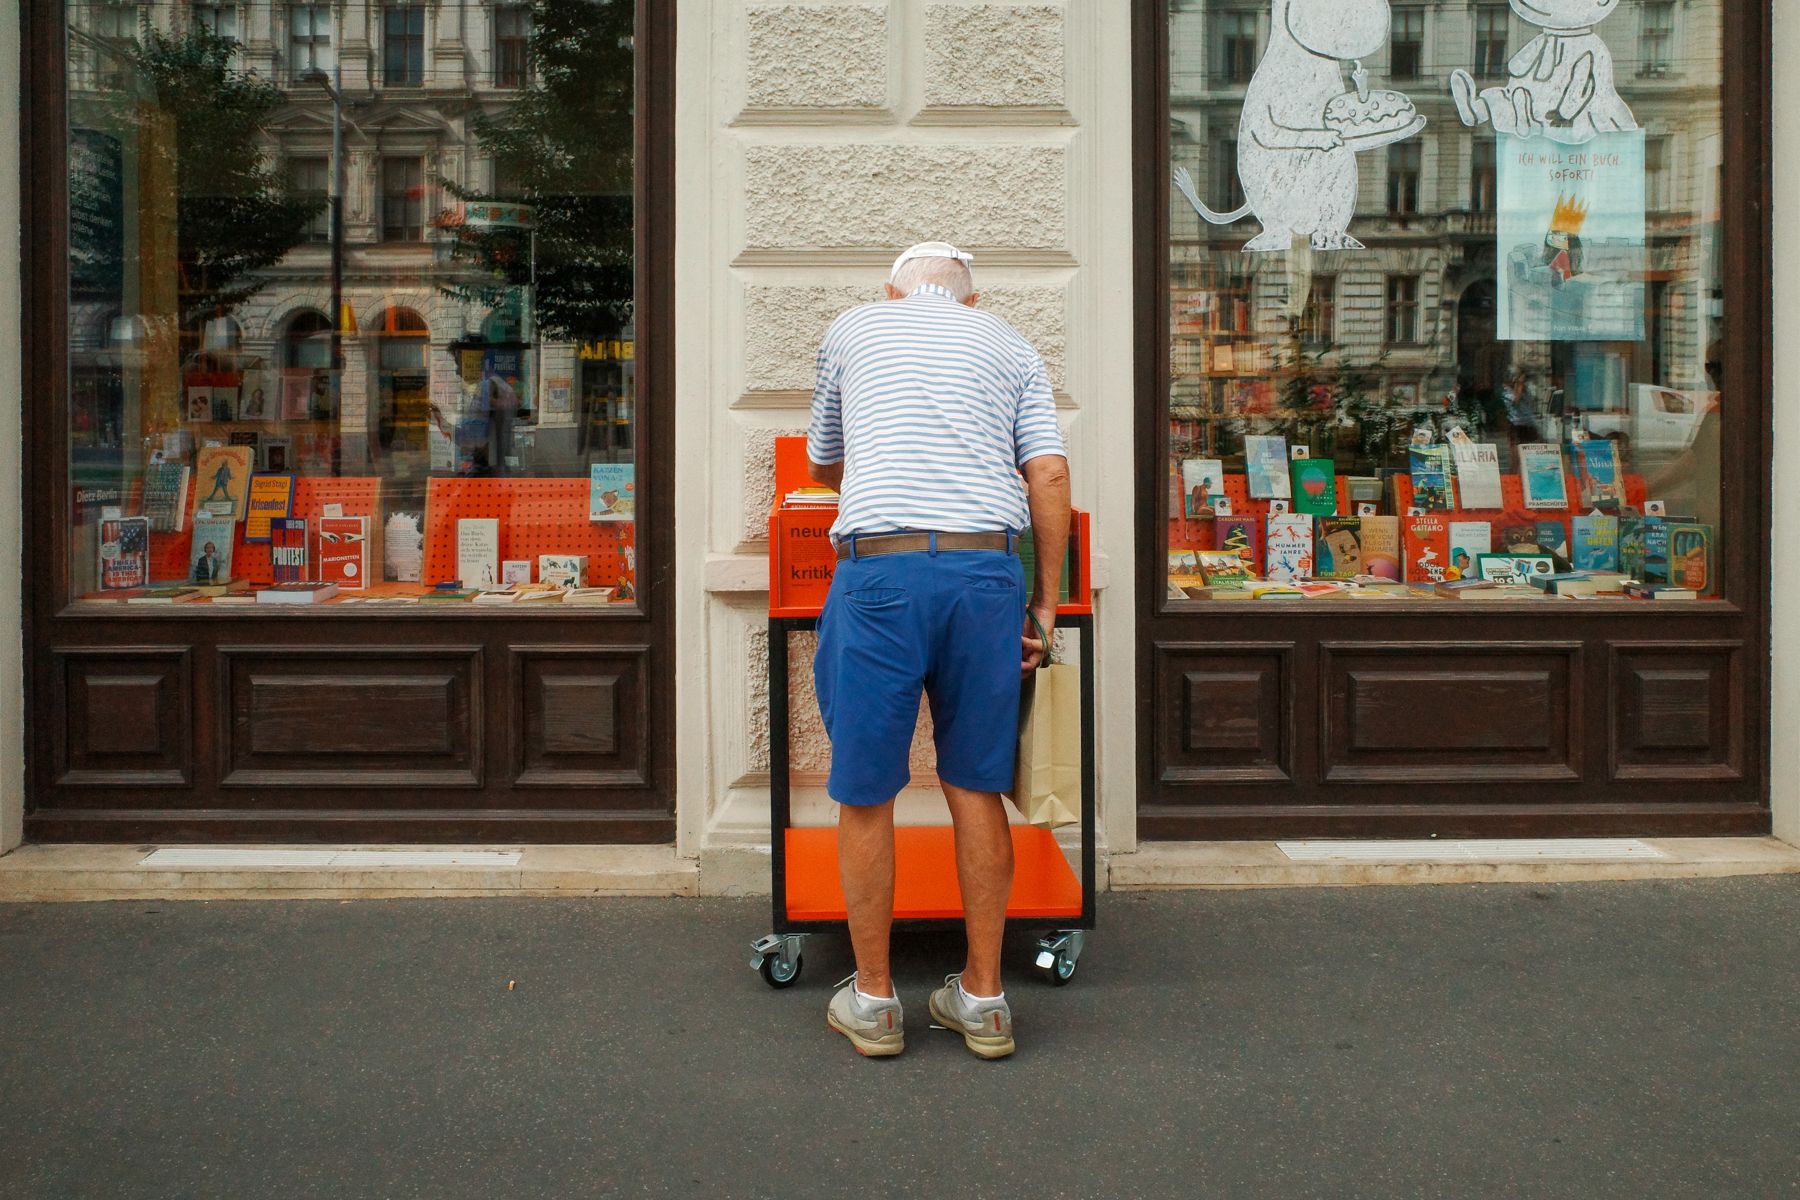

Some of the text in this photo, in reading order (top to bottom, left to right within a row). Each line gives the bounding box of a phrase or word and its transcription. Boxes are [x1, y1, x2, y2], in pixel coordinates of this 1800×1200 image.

[1518, 153, 1534, 166] ICH
[1539, 153, 1563, 165] WILL
[1568, 154, 1586, 166] EIN
[1549, 168, 1594, 182] SOFORT!
[593, 466, 623, 474] KATZEN
[76, 488, 118, 503] Dietz Berlin
[790, 527, 830, 538] neue
[272, 547, 305, 566] PROTEST
[323, 554, 360, 563] MARIONETTEN
[791, 564, 833, 579] kritik
